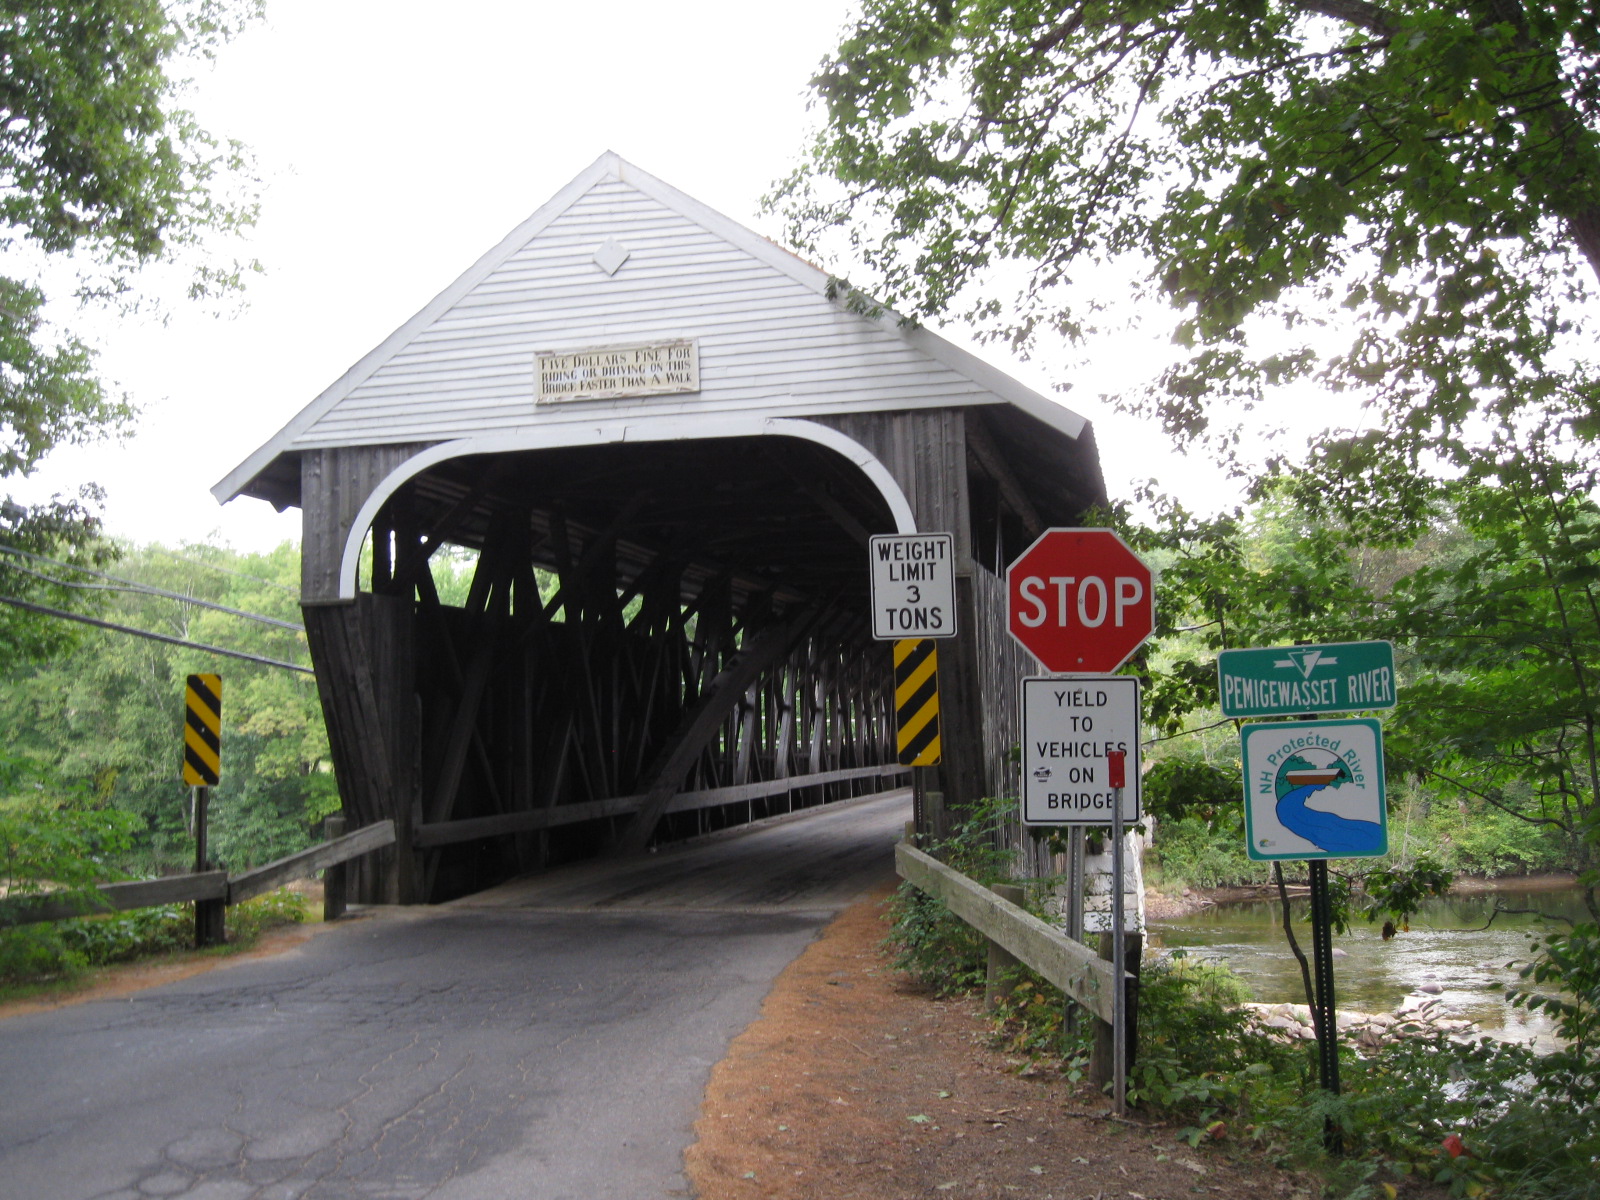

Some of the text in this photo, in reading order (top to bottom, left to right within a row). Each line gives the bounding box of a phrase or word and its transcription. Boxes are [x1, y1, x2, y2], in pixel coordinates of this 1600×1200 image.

[541, 347, 691, 371] FIVE DOLLARS FINE FOR
[541, 359, 691, 382] RIDING OR DRIVING ON THIS
[542, 371, 692, 394] BRIDGE FASTER THAN A WALK
[878, 540, 947, 561] WEIGHT
[889, 562, 937, 582] LIMIT
[906, 585, 921, 603] 3
[1018, 575, 1144, 629] STOP
[886, 606, 943, 631] TONS
[1224, 666, 1391, 710] PEMIGEWASSET RIVER
[1054, 691, 1108, 708] YIELD
[1070, 716, 1093, 733] TO
[1036, 741, 1128, 759] VEHICLES
[1259, 734, 1366, 794] NH Protected River
[1069, 767, 1094, 784] ON
[1048, 793, 1114, 810] BRIDGE
